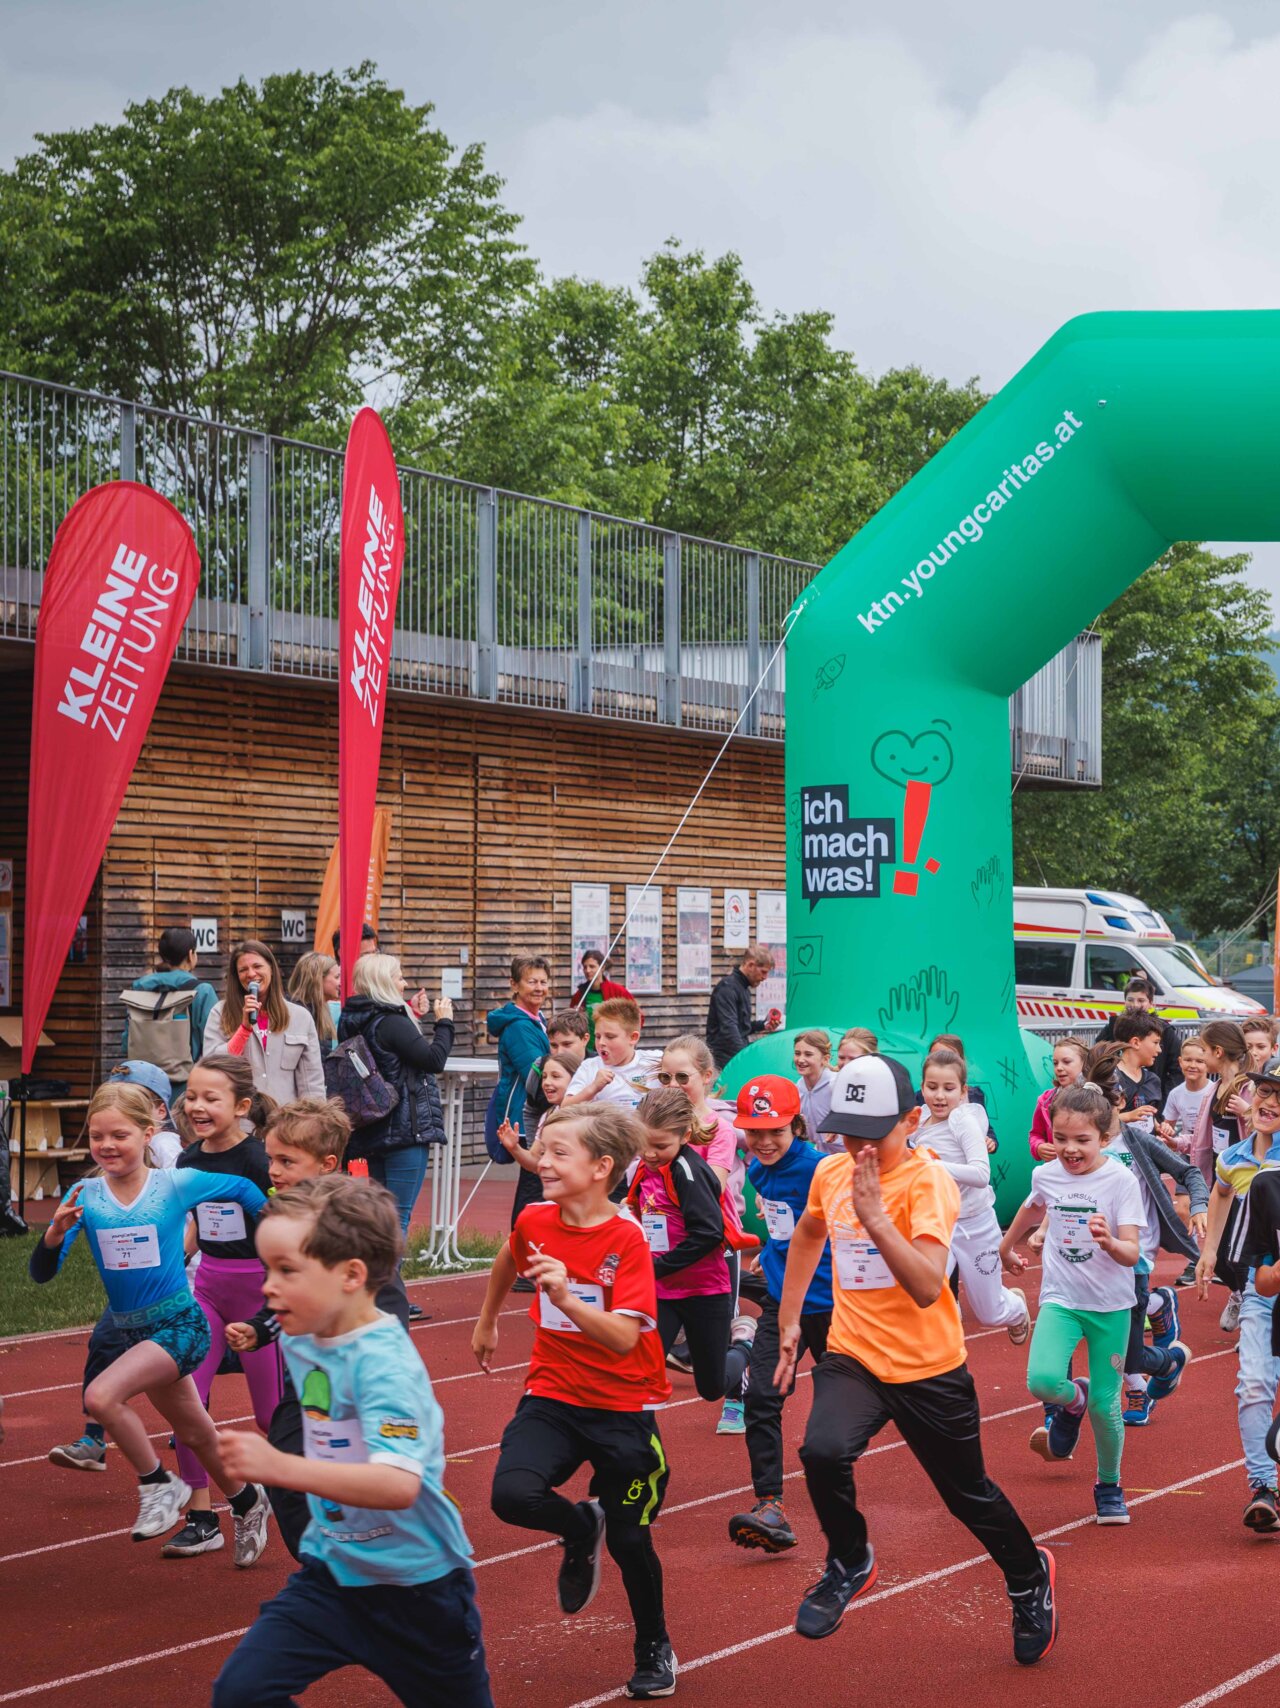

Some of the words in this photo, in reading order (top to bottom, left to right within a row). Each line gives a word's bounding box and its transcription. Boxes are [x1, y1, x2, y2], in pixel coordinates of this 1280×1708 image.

[856, 407, 1084, 635] ktn.youngcaritas.at
[350, 483, 383, 702] KLEINE
[57, 543, 149, 725] KLEINE
[363, 514, 394, 728] ZEITUNG
[91, 562, 180, 742] ZEITUNG
[803, 791, 844, 824] ich
[803, 826, 889, 859] mach
[804, 860, 875, 893] was!
[192, 929, 215, 947] WC
[283, 920, 304, 937] WC
[146, 1291, 190, 1321] PRO
